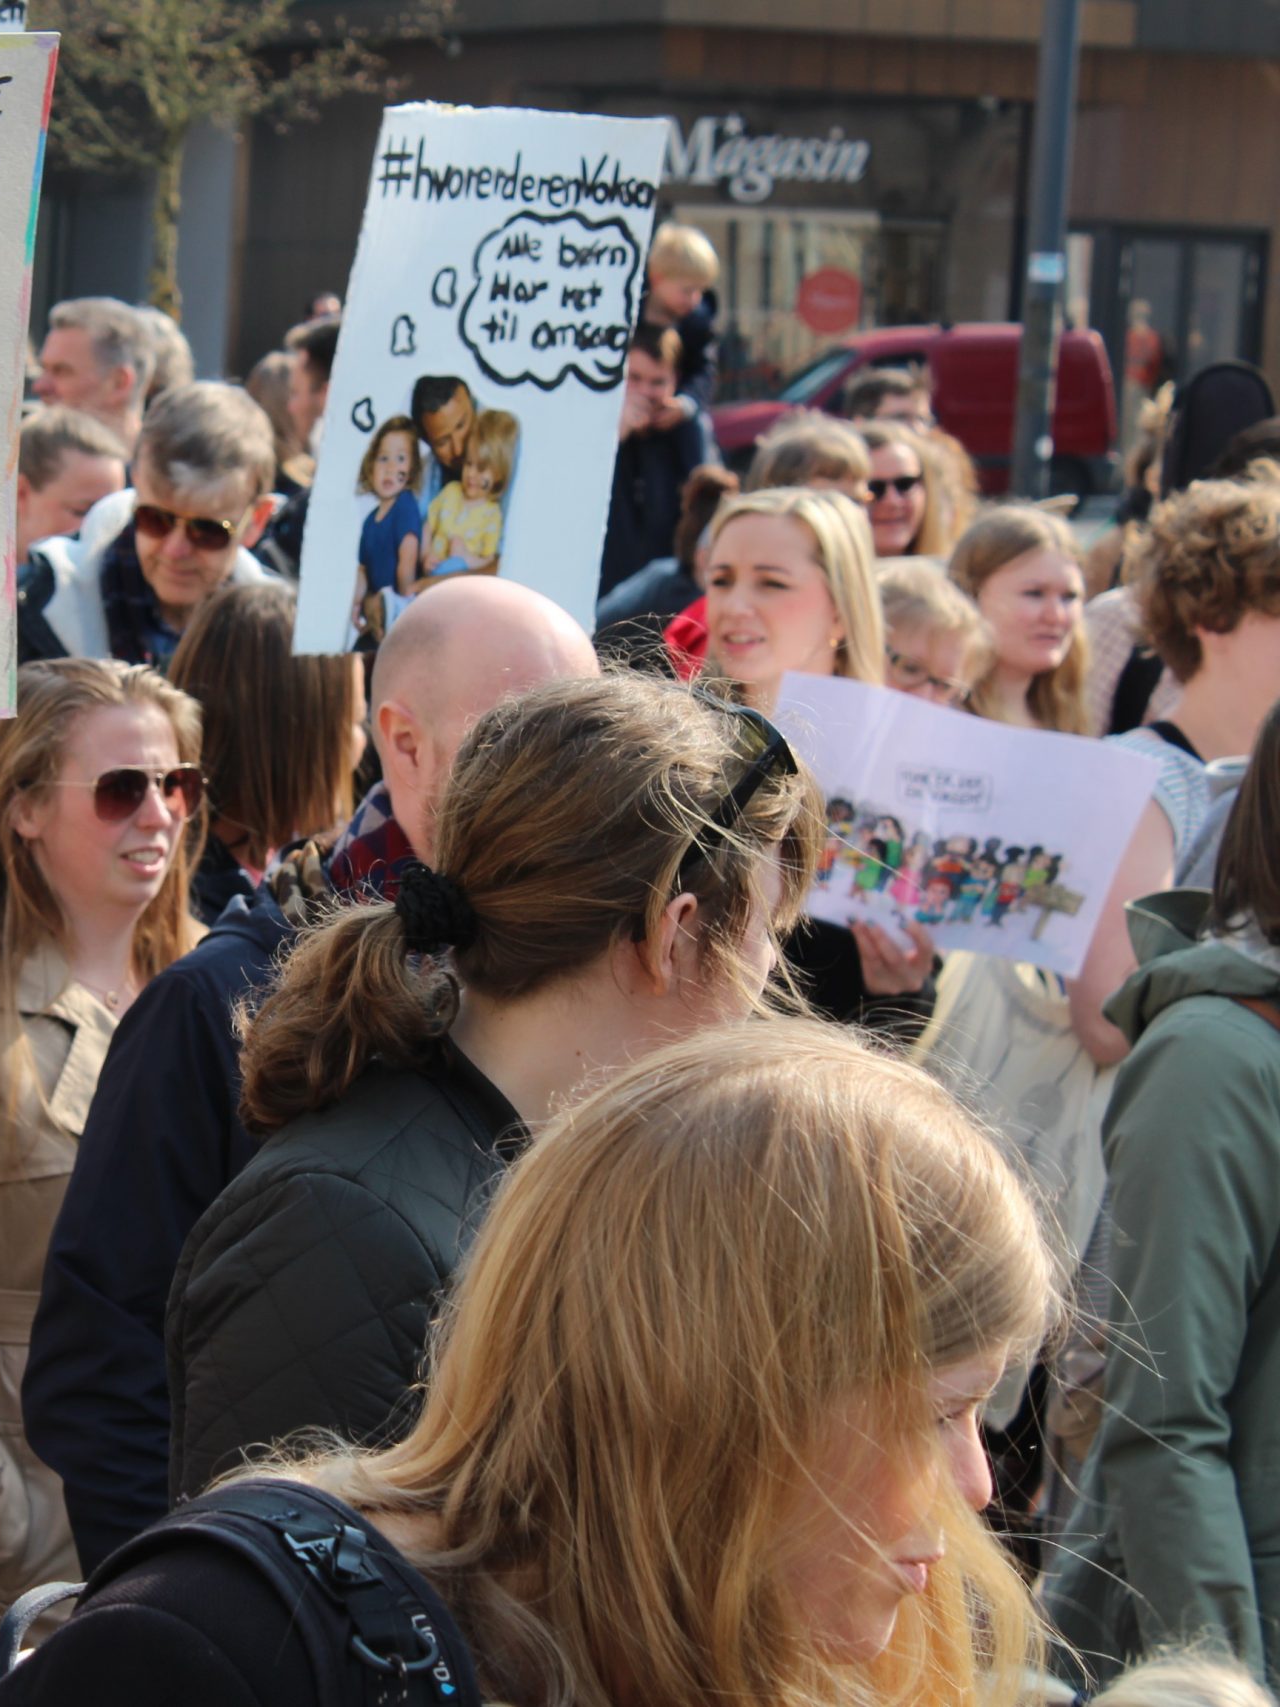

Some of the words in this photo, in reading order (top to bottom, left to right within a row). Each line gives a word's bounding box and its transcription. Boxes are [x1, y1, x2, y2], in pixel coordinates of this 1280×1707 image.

[658, 112, 870, 202] Magasin
[489, 271, 548, 304] Har
[480, 309, 517, 343] til
